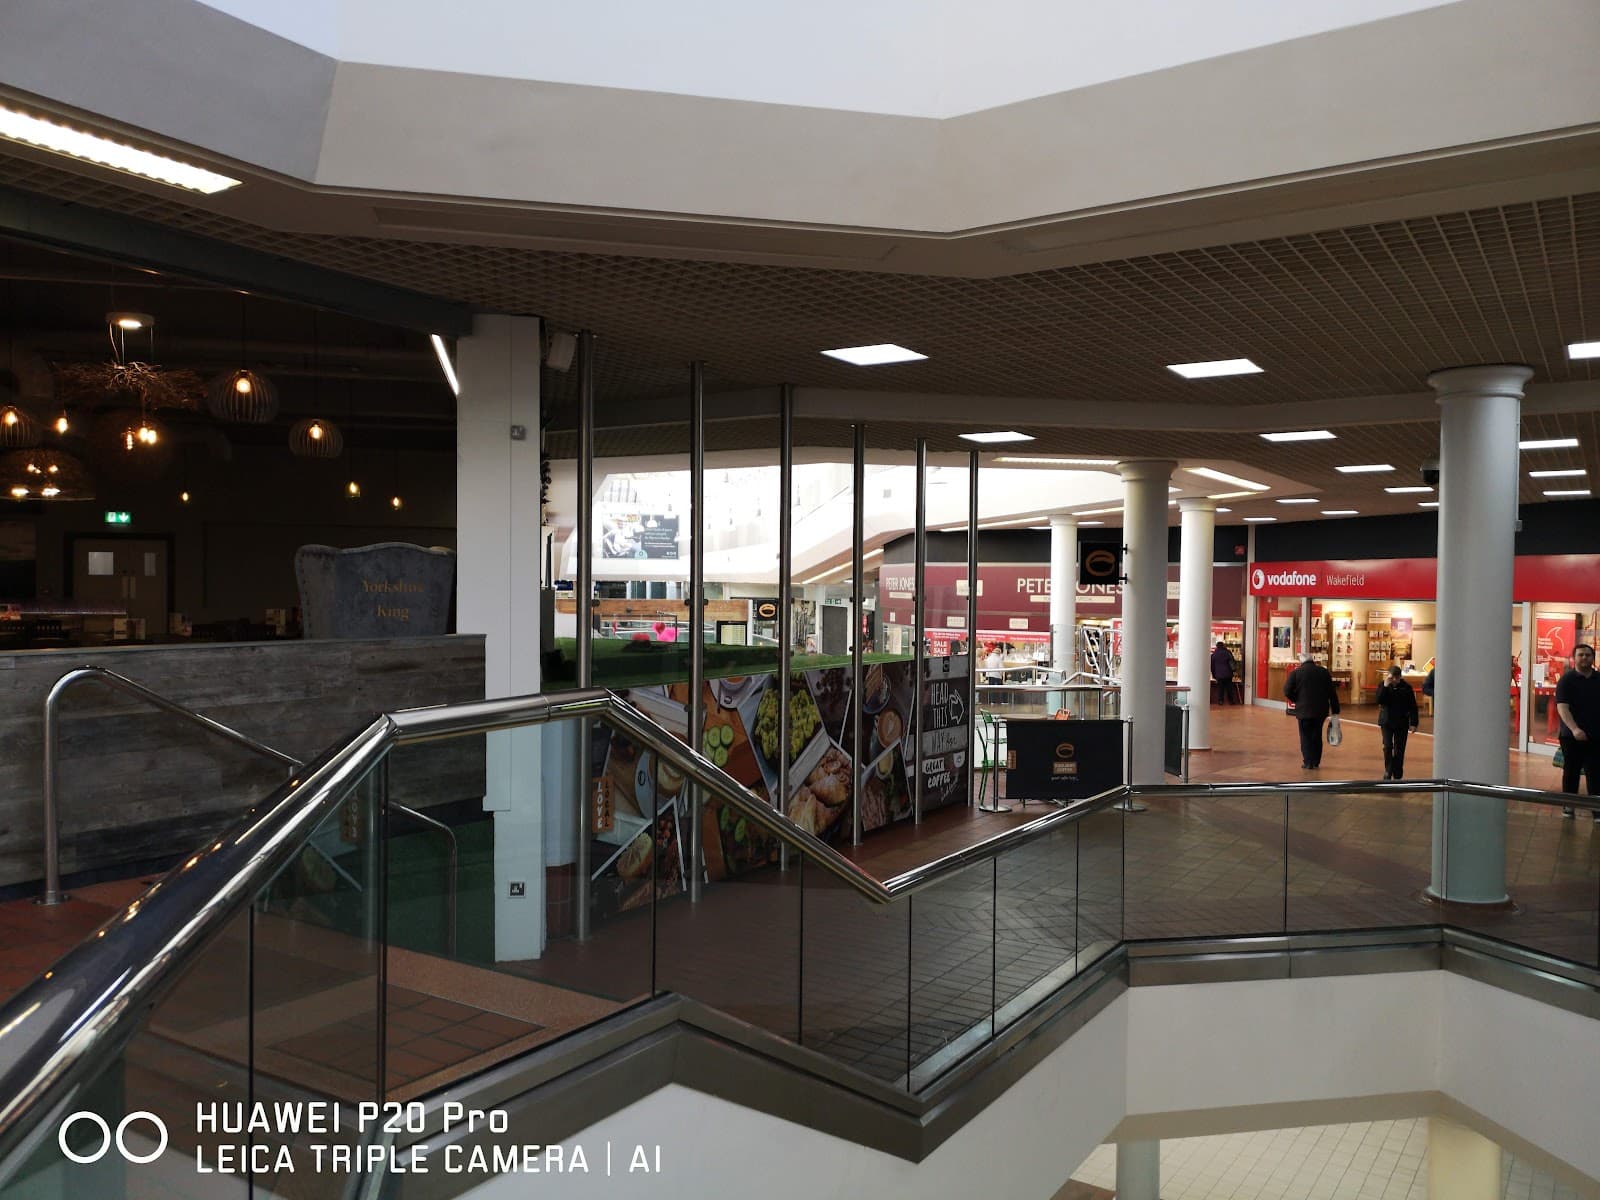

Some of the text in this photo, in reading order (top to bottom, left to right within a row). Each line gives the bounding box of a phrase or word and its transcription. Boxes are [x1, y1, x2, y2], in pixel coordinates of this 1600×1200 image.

[885, 577, 899, 591] PETER
[1017, 578, 1122, 594] PETE ONES
[1267, 570, 1365, 586] vodafone Wakefield
[377, 605, 409, 620] King
[931, 682, 948, 705] HEAD
[933, 707, 948, 729] THIS
[925, 759, 944, 773] GREAT
[927, 772, 951, 788] COFFEE
